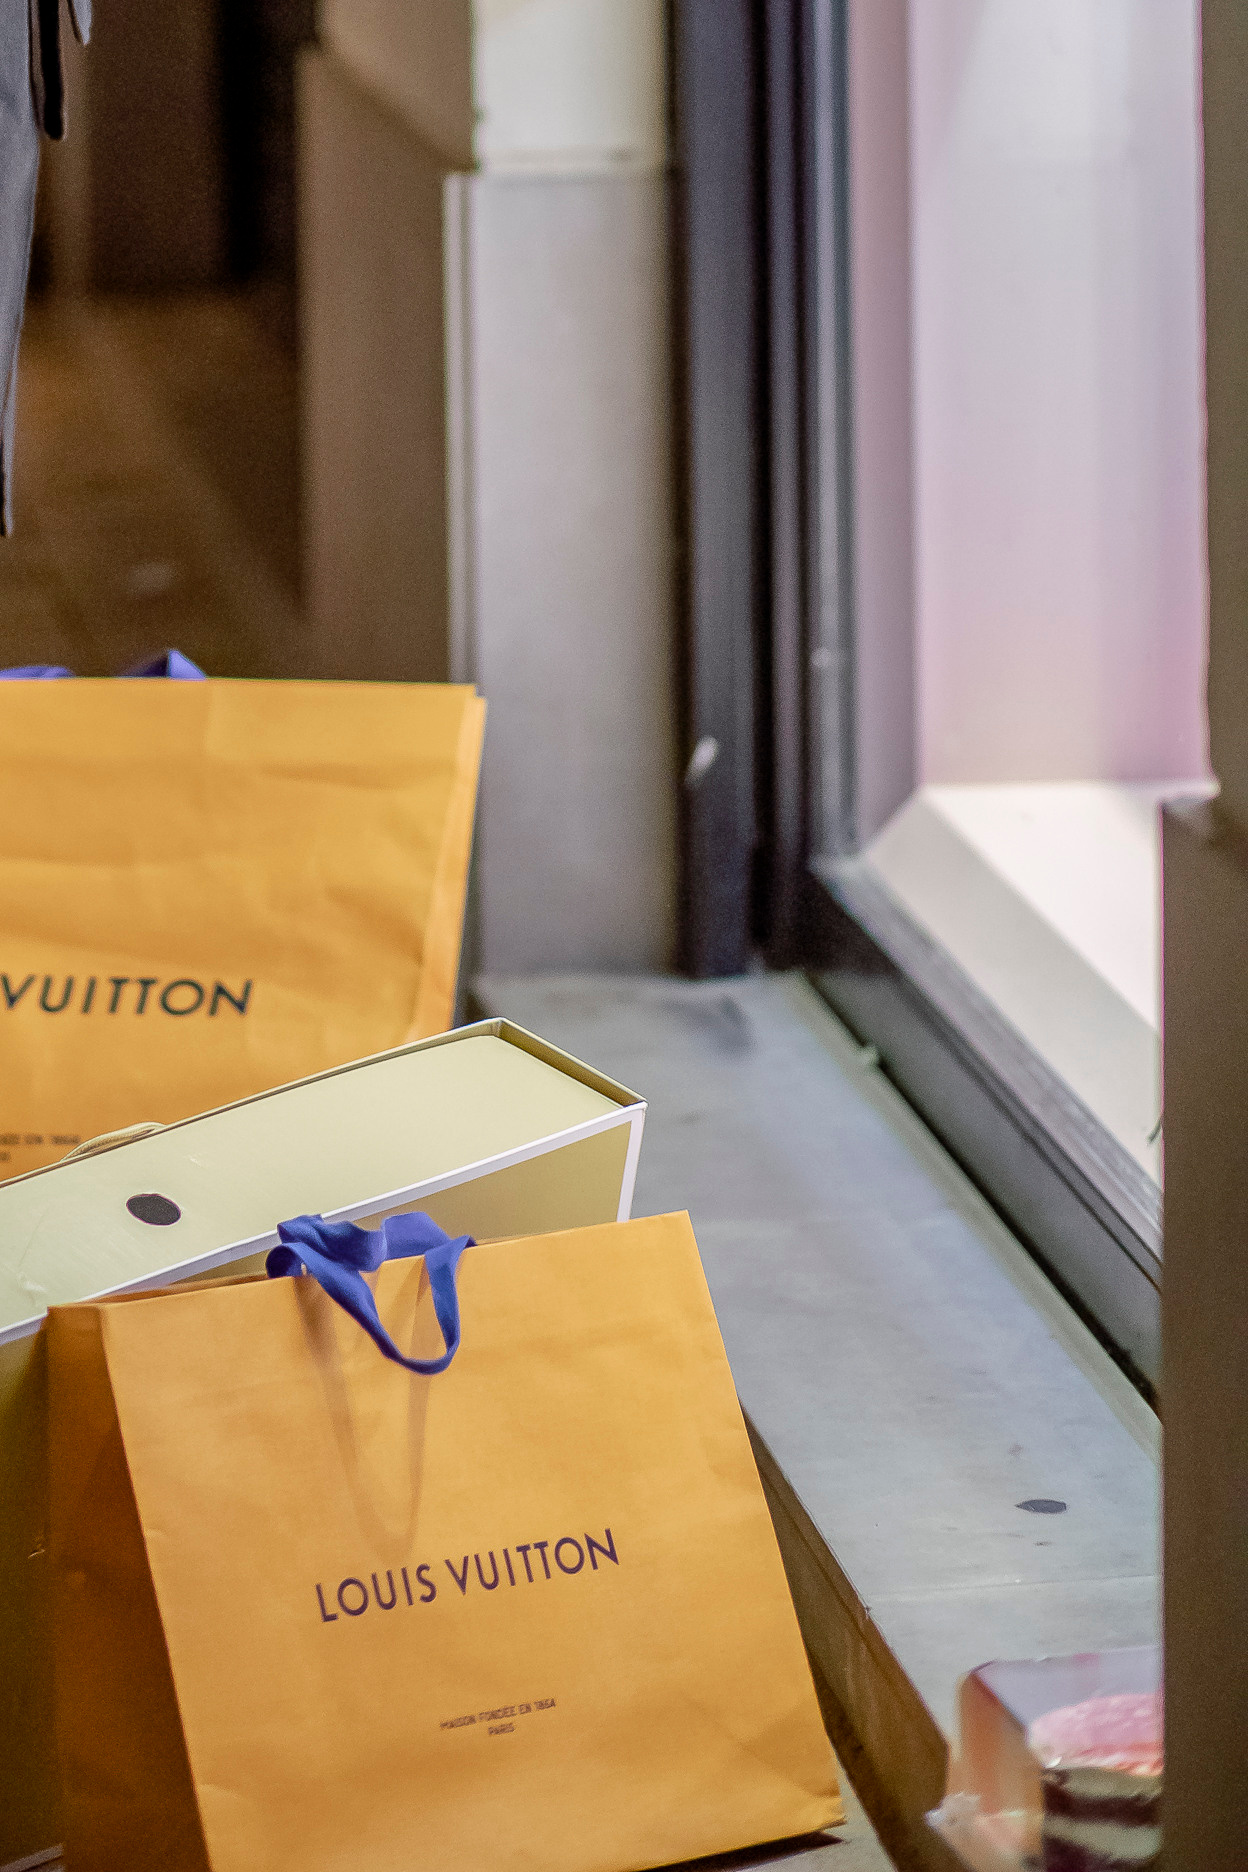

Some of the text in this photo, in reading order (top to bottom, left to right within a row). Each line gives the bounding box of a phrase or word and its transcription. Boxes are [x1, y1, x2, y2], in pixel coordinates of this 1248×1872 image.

[0, 973, 253, 1017] VUITTON
[315, 1528, 620, 1623] LOUIS VUITTON
